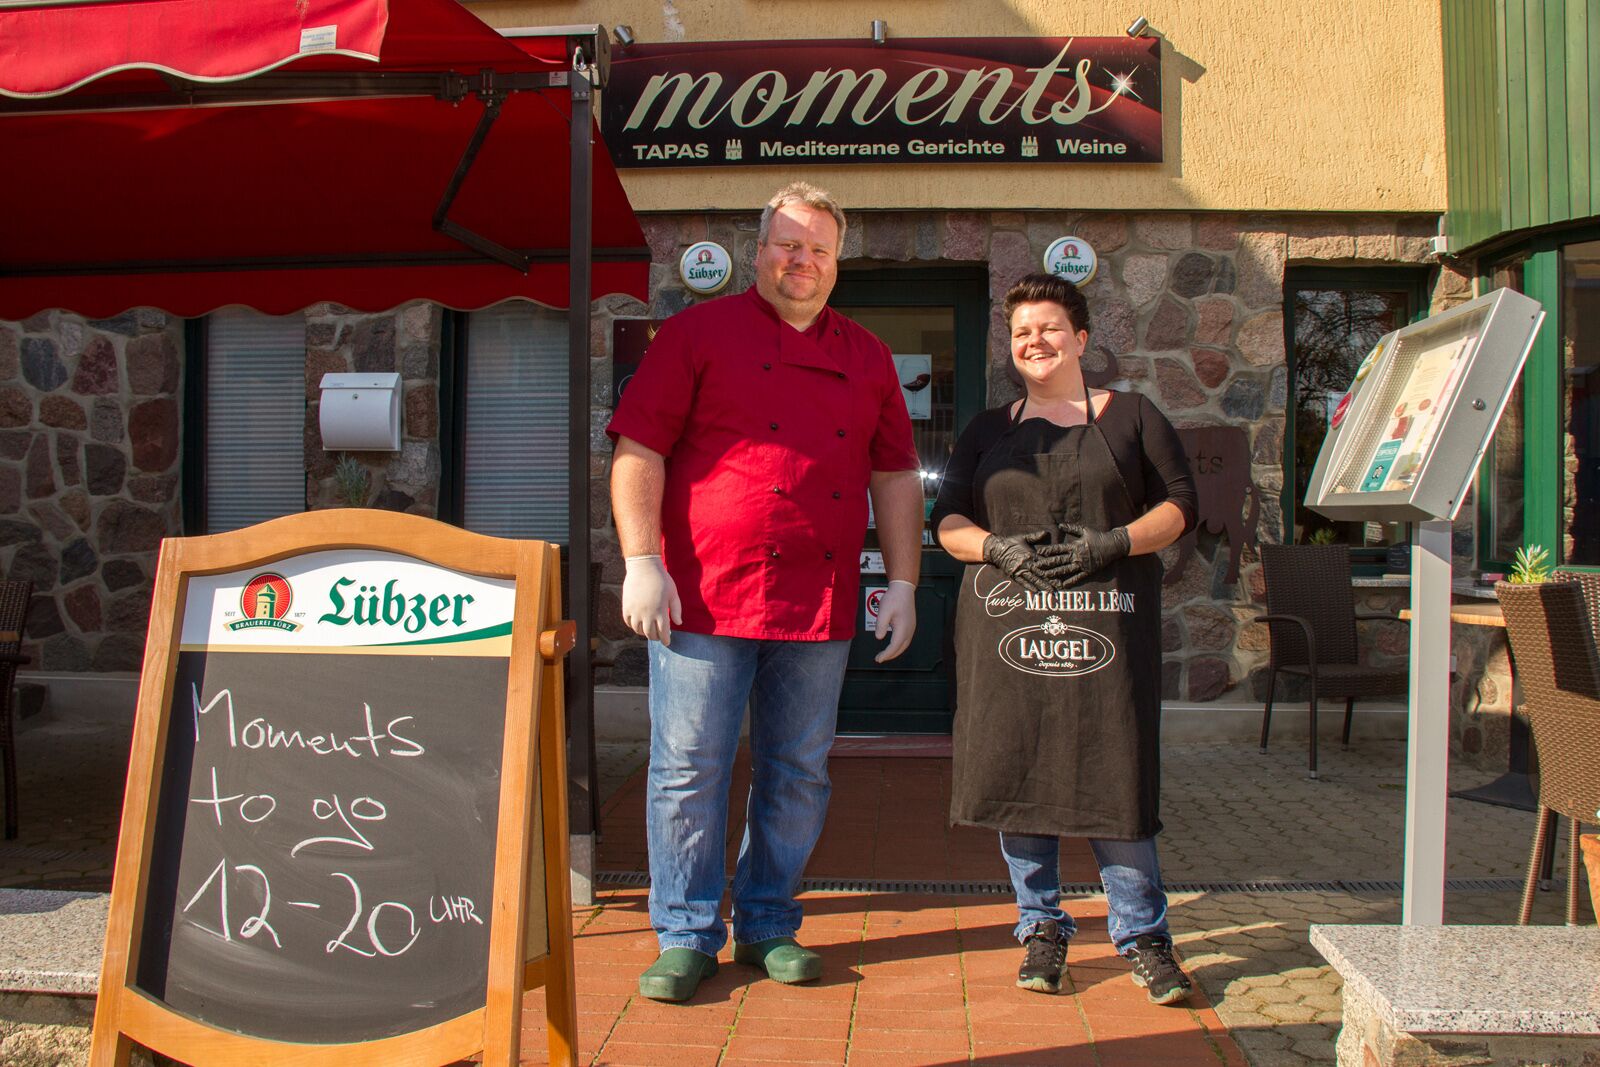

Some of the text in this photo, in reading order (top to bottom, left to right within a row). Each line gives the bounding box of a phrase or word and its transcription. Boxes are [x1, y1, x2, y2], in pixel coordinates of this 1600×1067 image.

[623, 37, 1124, 132] moments
[633, 139, 1127, 160] TAPAS Mediterrane Gerichte Weine
[688, 267, 723, 280] Lübzer
[1053, 261, 1089, 275] Lübzer
[318, 576, 475, 634] Lübzer
[1025, 590, 1095, 612] MICHEL
[1020, 637, 1096, 661] LAUGEL
[192, 681, 425, 757] Moments
[190, 766, 387, 858] to go
